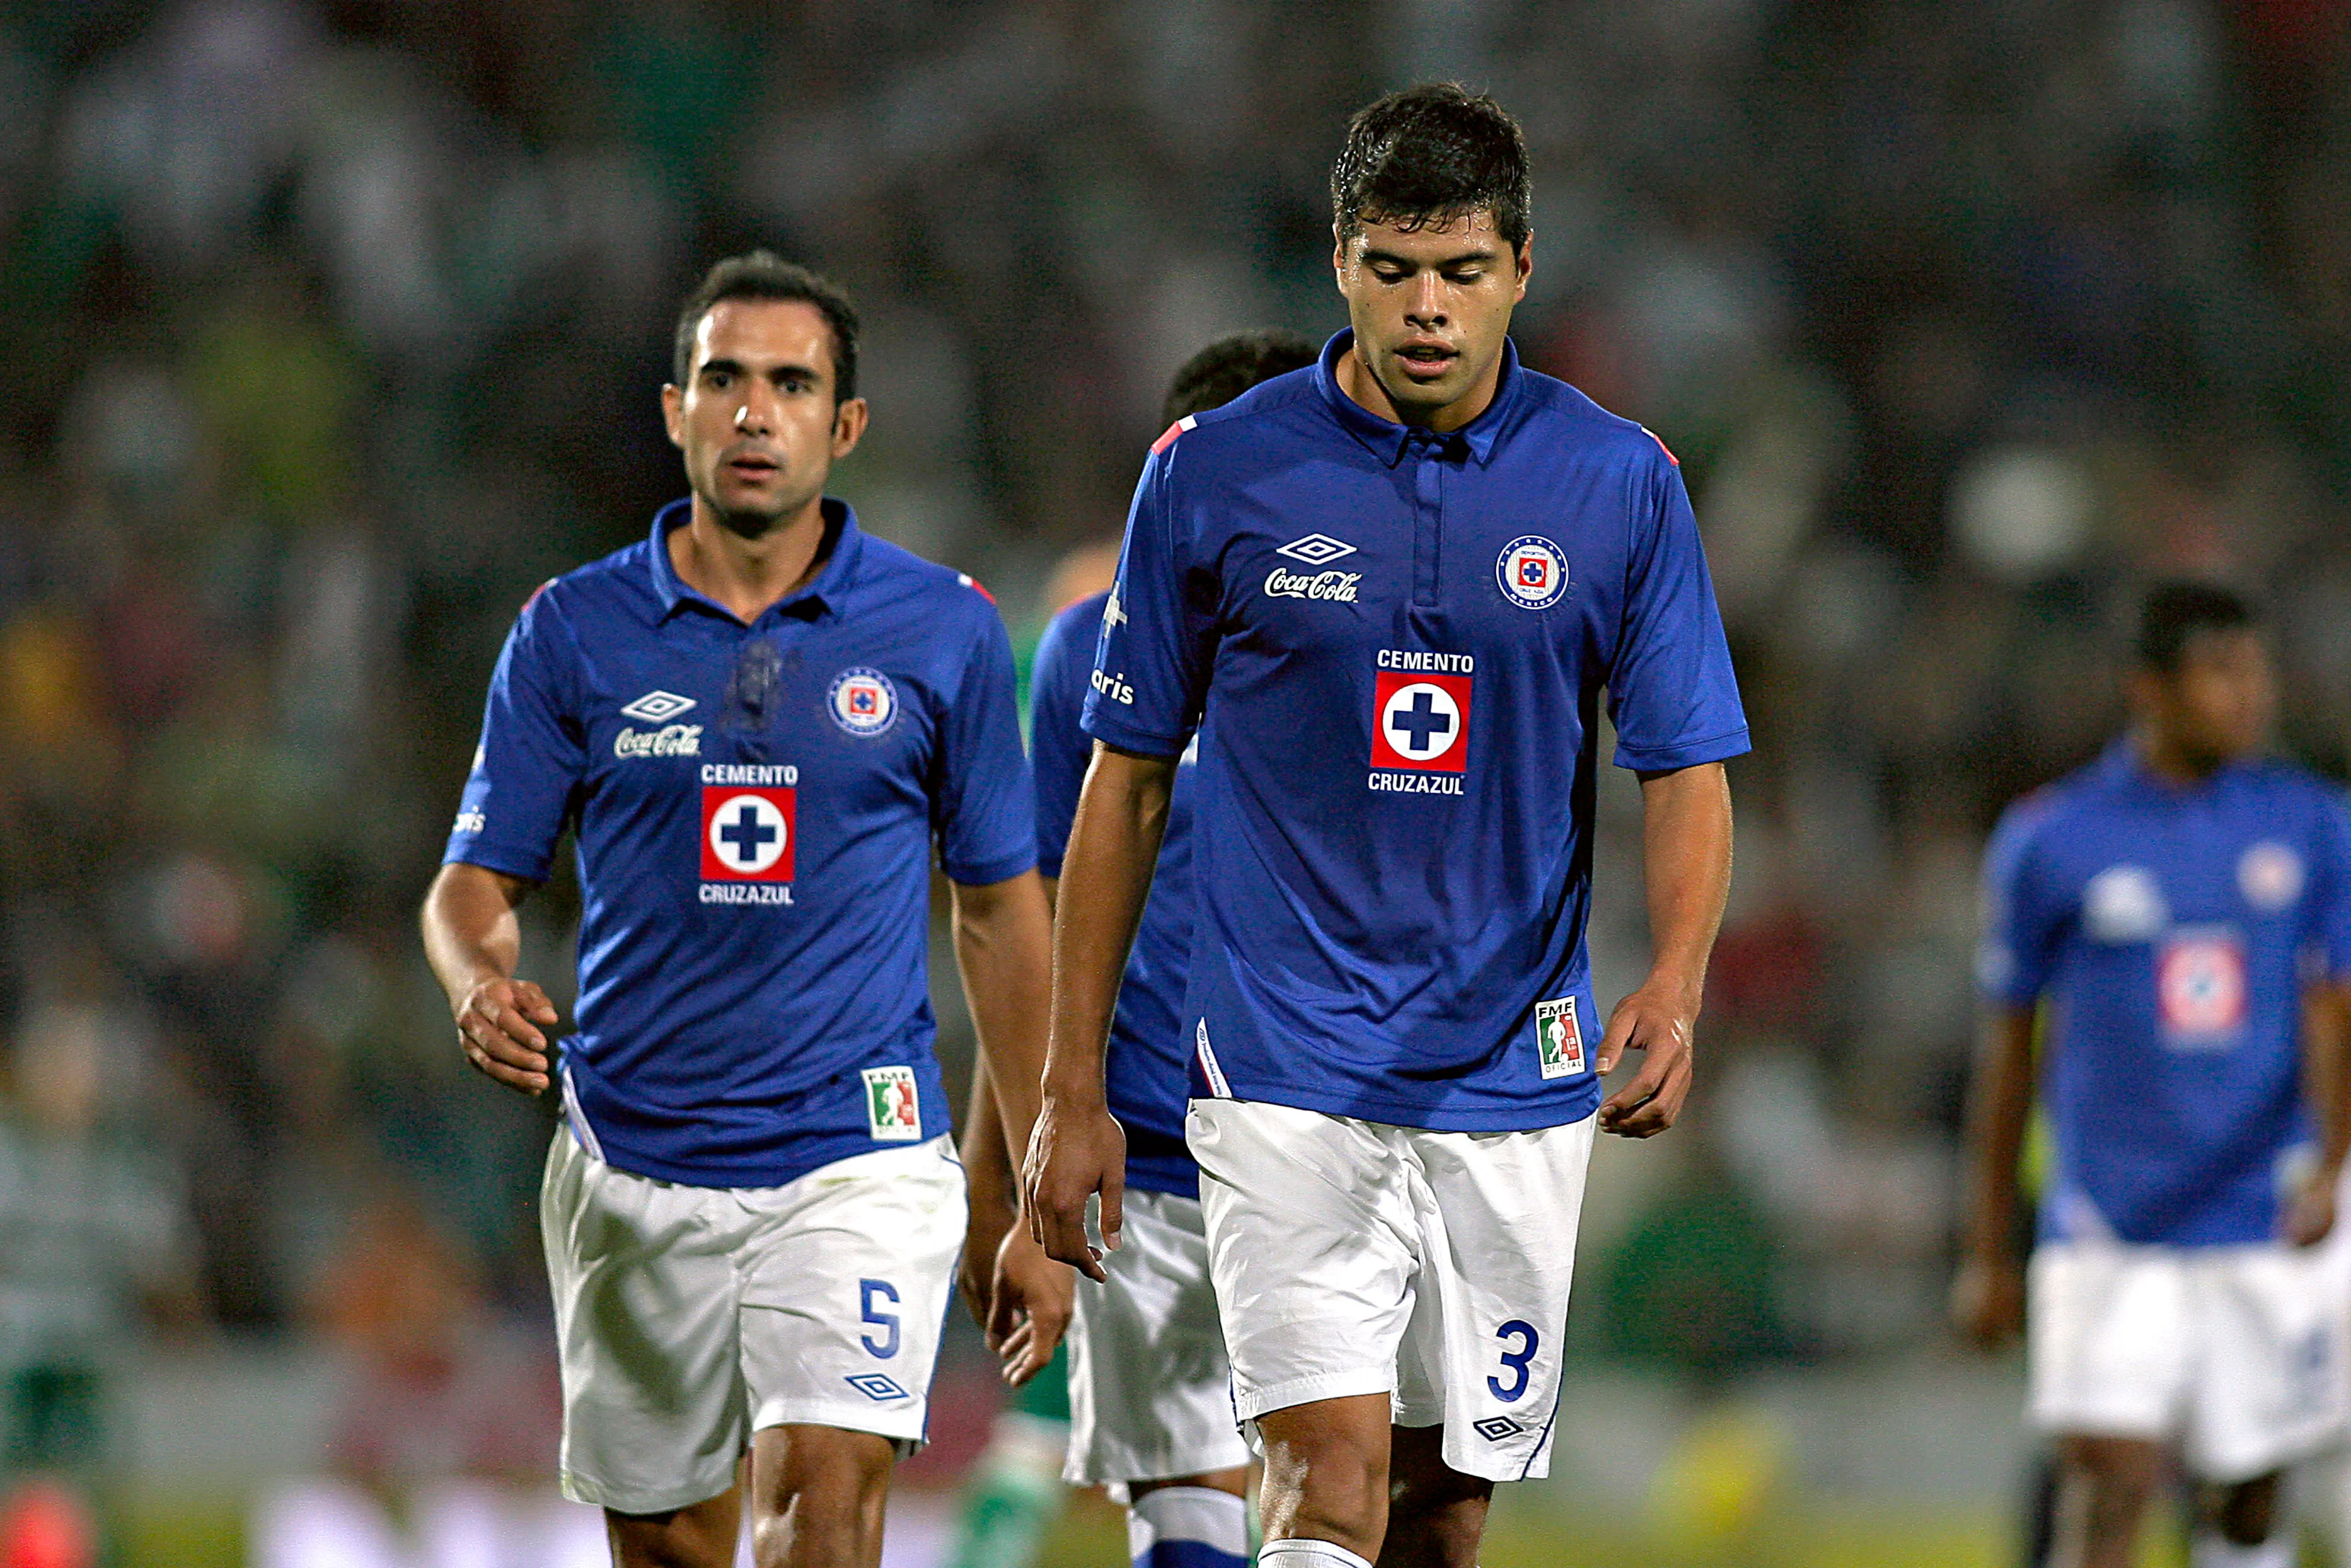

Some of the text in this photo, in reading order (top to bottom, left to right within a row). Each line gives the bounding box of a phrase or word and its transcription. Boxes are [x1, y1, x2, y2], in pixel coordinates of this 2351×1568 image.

[1264, 567, 1362, 603] Coca-Cola
[1377, 649, 1474, 673] CEMENTO
[701, 764, 799, 786] CEMENTO
[1368, 772, 1465, 795] CRUZAZUL
[698, 883, 795, 905] CRUZAZUL
[1538, 1001, 1572, 1018] FMF
[1546, 1060, 1582, 1073] OFICIAL
[859, 1277, 900, 1359] 5
[1487, 1319, 1539, 1403] 3
